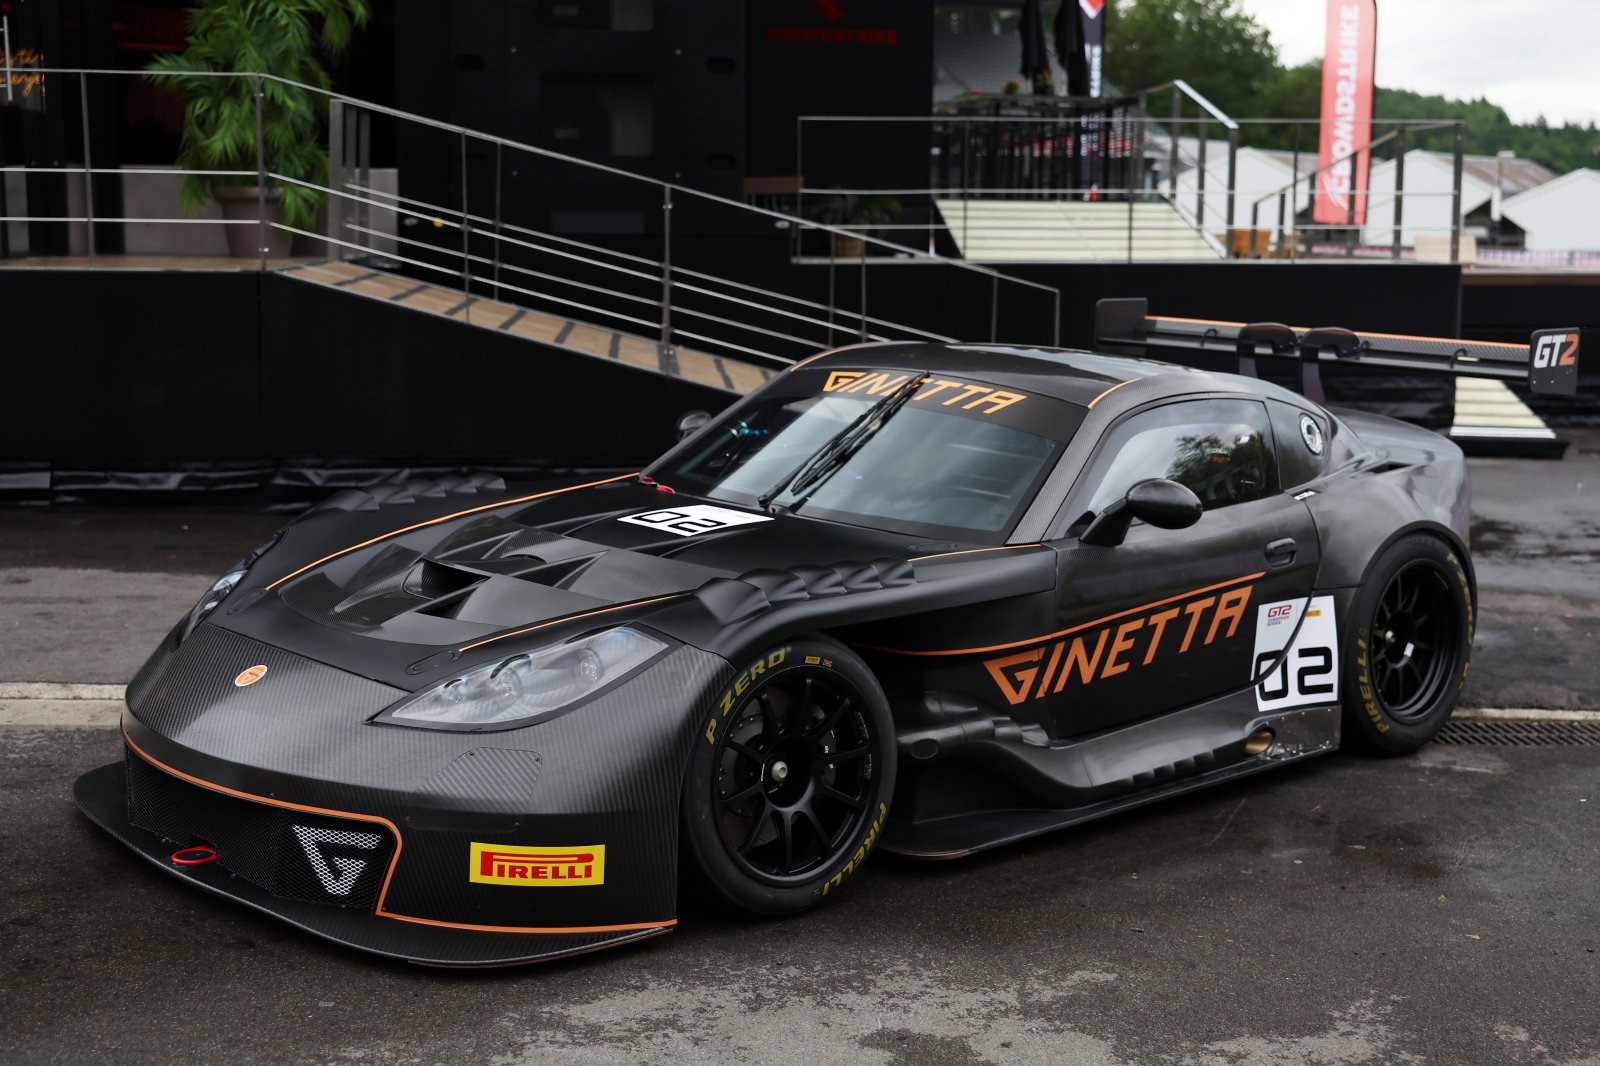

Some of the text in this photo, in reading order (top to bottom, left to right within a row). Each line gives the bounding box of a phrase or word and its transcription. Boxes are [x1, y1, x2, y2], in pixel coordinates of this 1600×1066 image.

[1534, 333, 1579, 369] GT2
[631, 511, 728, 533] 02
[1268, 605, 1291, 617] GT2
[983, 585, 1253, 705] GINETTA
[704, 649, 786, 746] P ZERO
[1254, 646, 1333, 701] 02
[1356, 638, 1390, 734] PIRELLI
[480, 850, 594, 879] PIRELLI
[822, 800, 887, 897] PIRELLI
